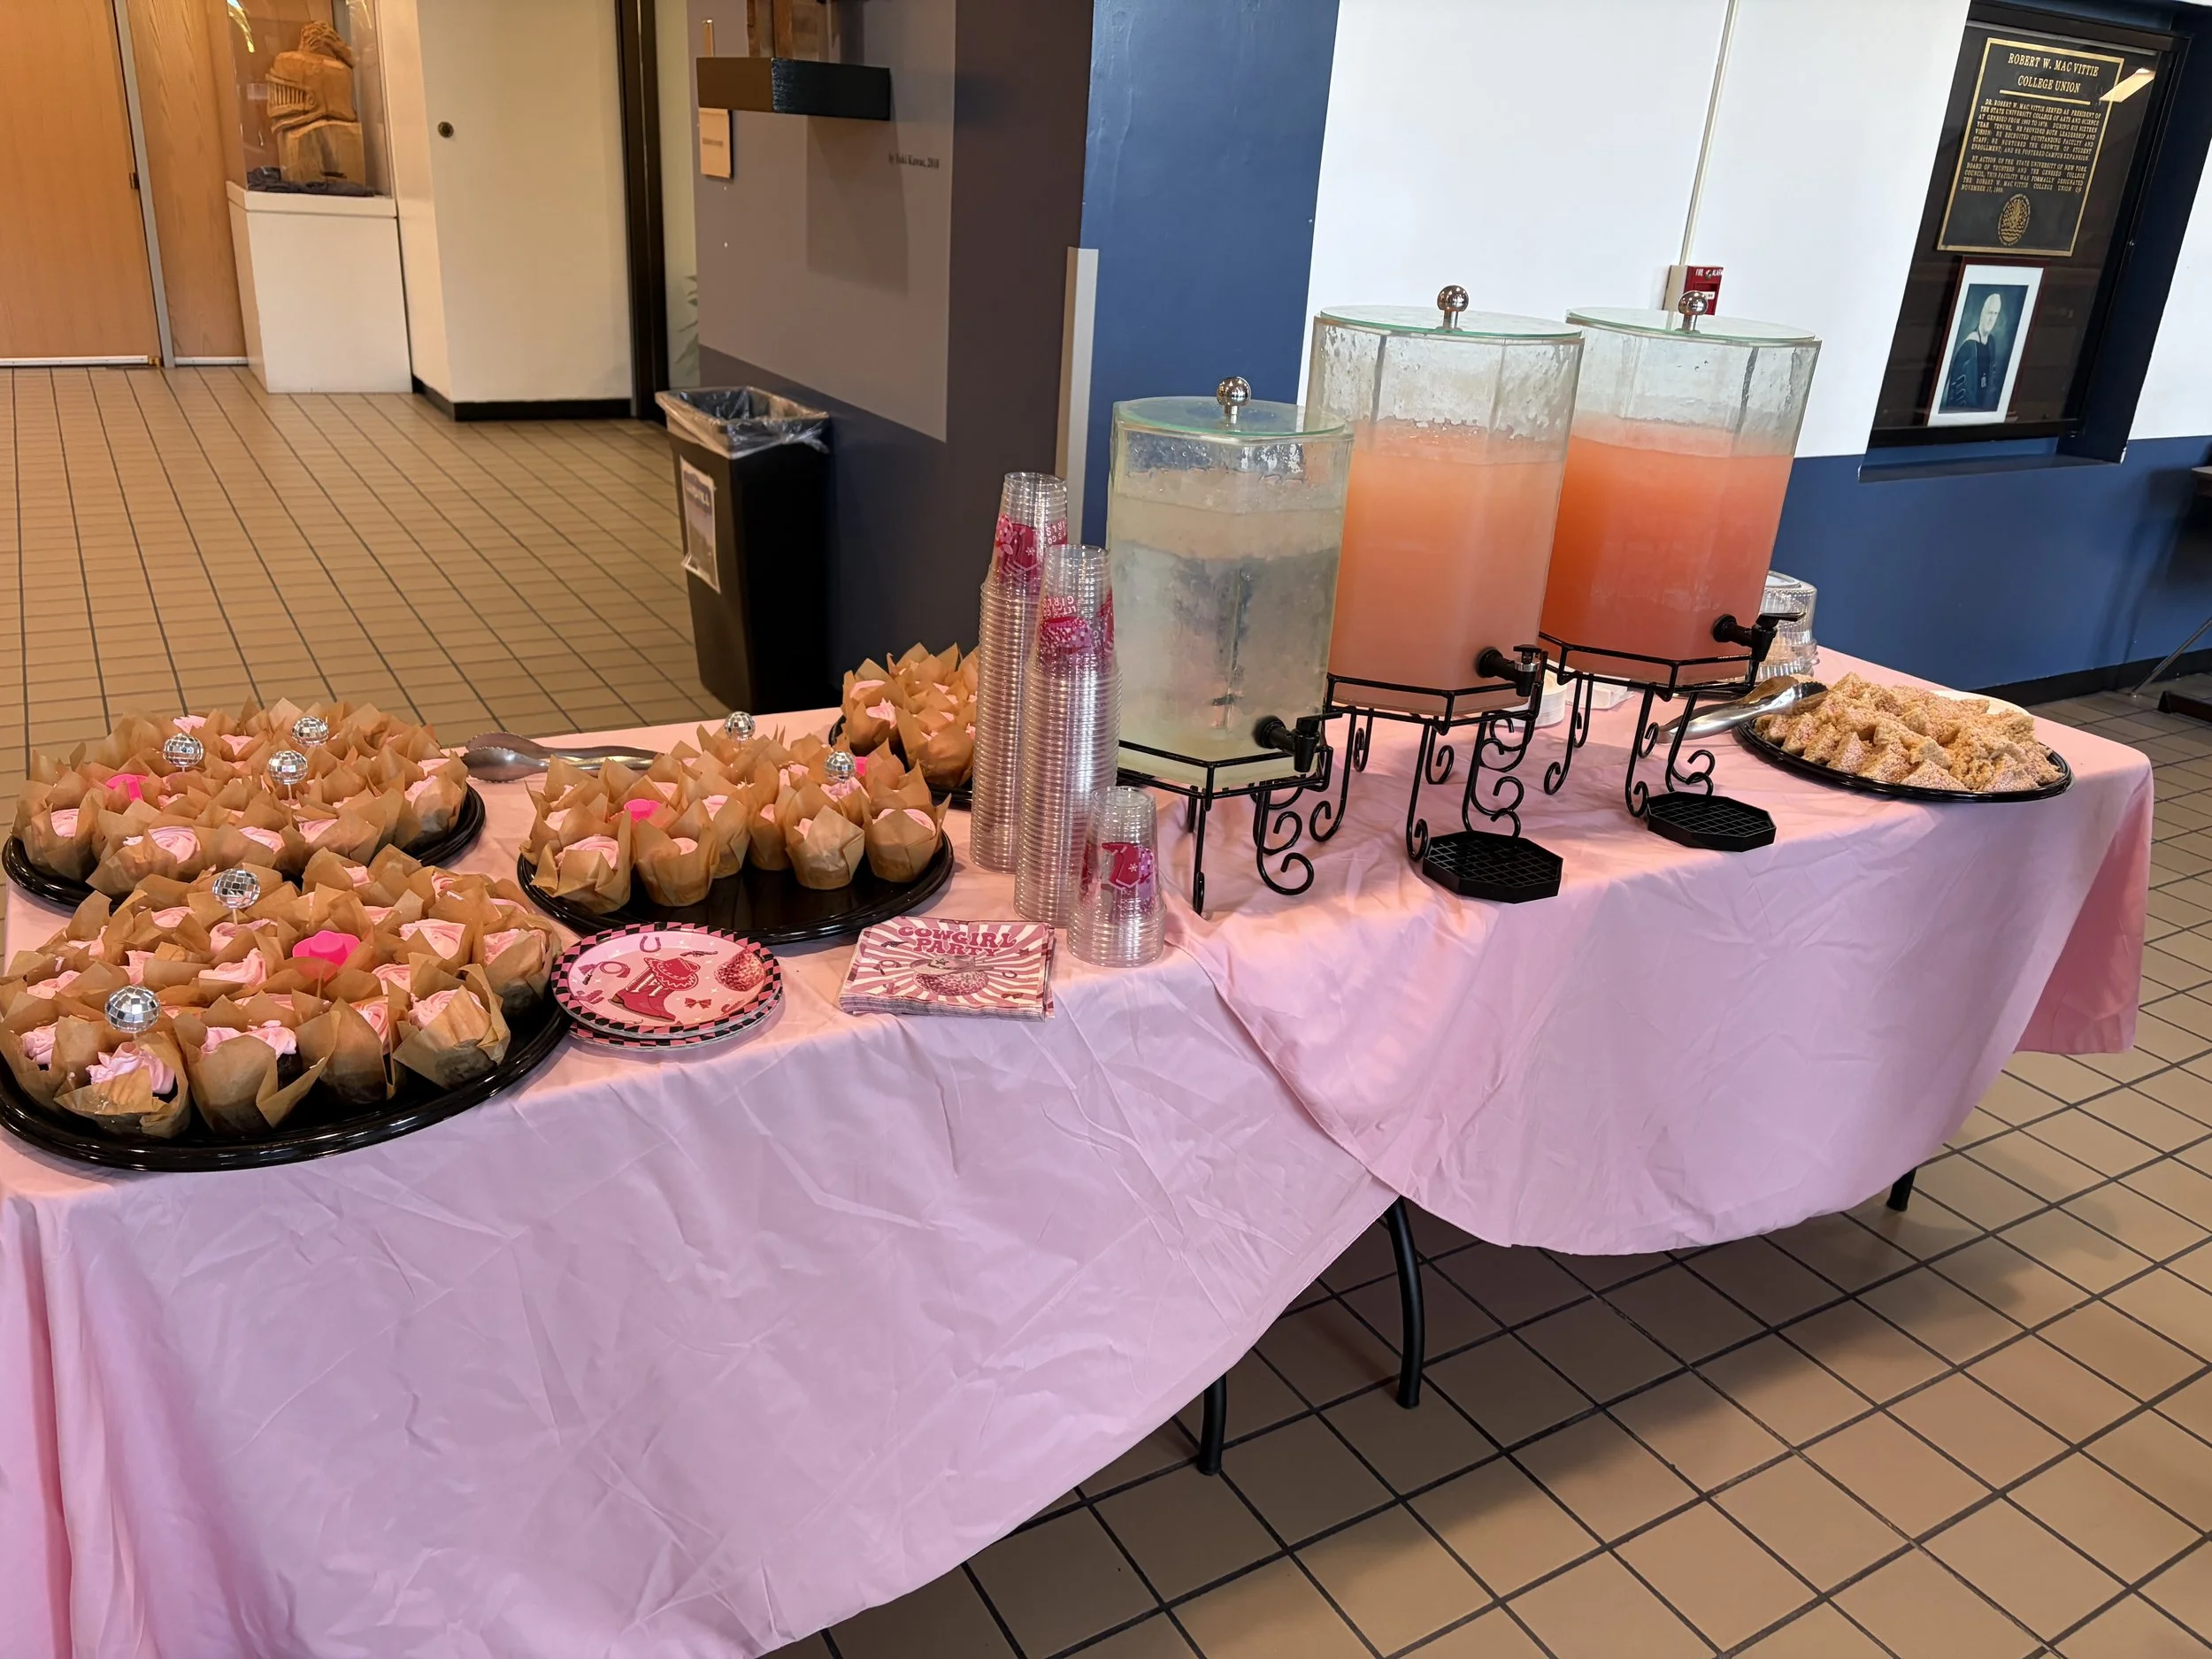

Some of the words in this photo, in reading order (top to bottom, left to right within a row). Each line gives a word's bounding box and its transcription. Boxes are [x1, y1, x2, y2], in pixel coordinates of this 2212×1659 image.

[2008, 53, 2041, 67] ROBERT
[2042, 58, 2053, 69] W.
[2055, 60, 2073, 72] MAC
[2073, 63, 2099, 76] VITTIE
[2018, 75, 2054, 89] COLLEGE
[2055, 80, 2081, 93] UNION
[2006, 109, 2032, 118] UNIVERSITY
[2071, 110, 2094, 118] PRESIDENT
[2031, 135, 2061, 143] OUTSTANDING
[1046, 521, 1066, 537] IRLS
[1043, 595, 1074, 608] GIRLS
[898, 926, 1017, 948] COWGIRL
[914, 938, 1001, 957] PARTY
